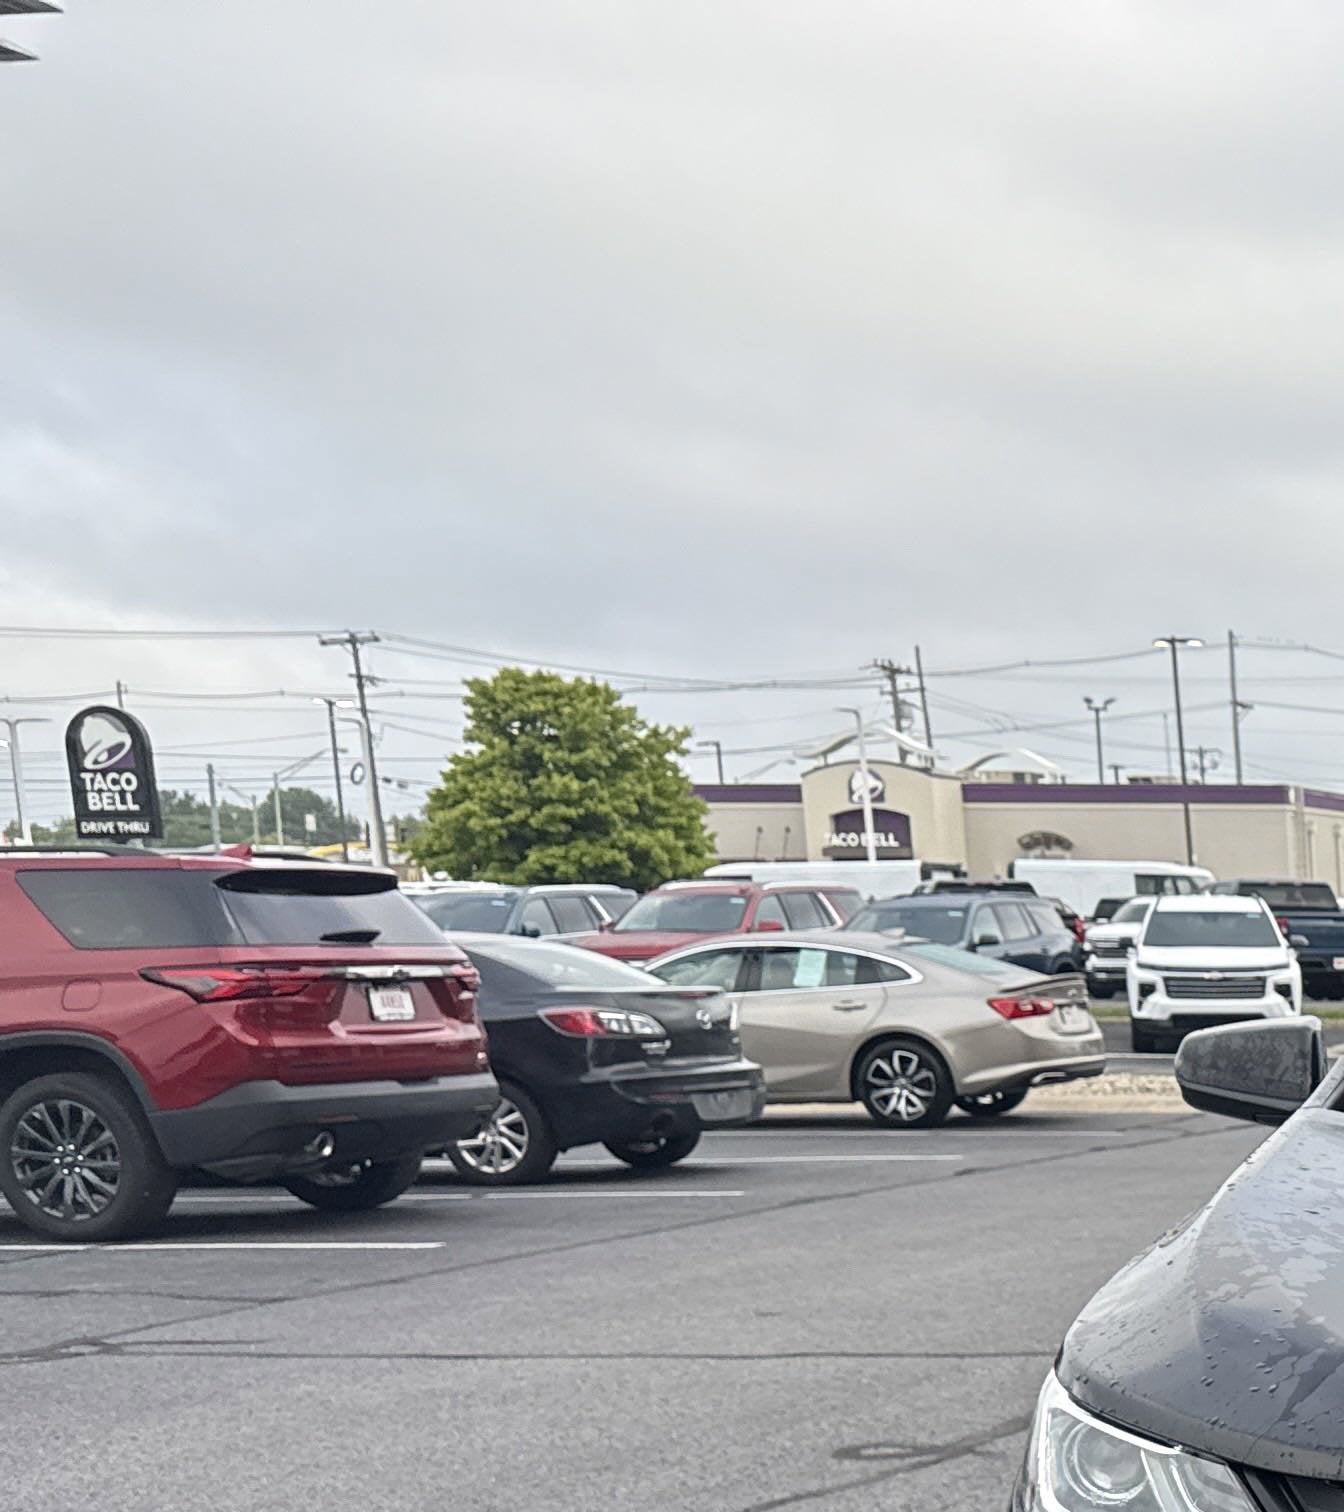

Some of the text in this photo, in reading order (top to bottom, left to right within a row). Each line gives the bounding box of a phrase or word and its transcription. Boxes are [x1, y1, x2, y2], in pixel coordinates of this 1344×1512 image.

[80, 771, 138, 791] TACO
[87, 791, 140, 811] BELL
[80, 821, 150, 834] DRIVE THRU
